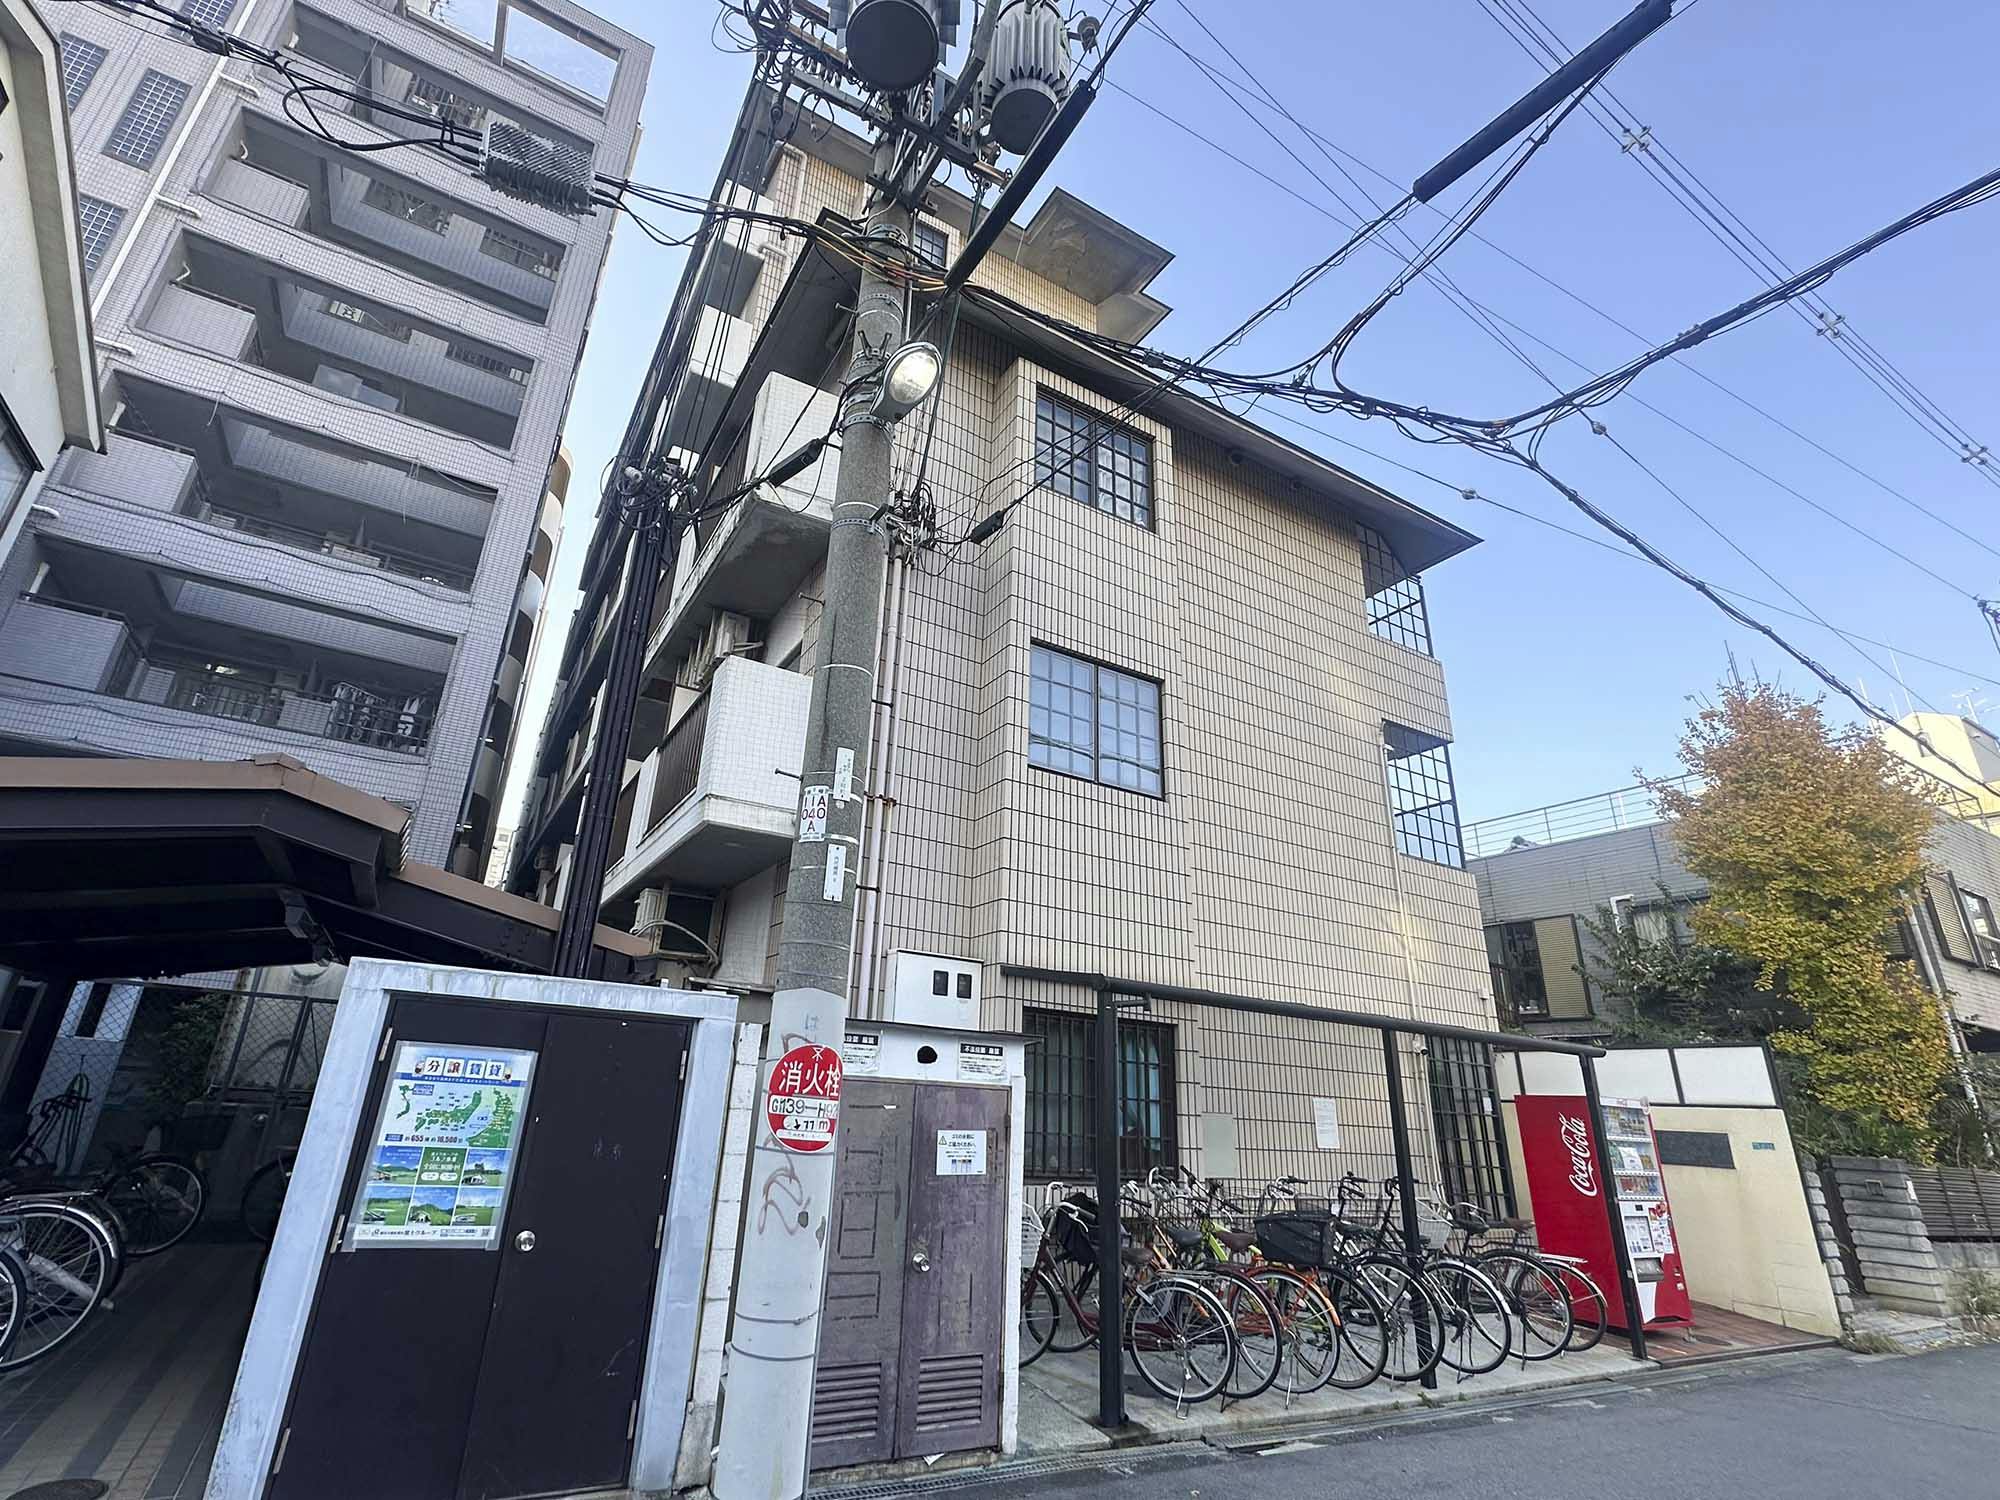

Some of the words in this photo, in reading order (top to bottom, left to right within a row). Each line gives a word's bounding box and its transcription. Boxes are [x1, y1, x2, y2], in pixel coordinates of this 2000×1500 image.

[801, 807, 826, 820] 040
[806, 820, 816, 832] A
[779, 1058, 841, 1097] 消火栓
[1558, 1112, 1598, 1197] Coca-Cola
